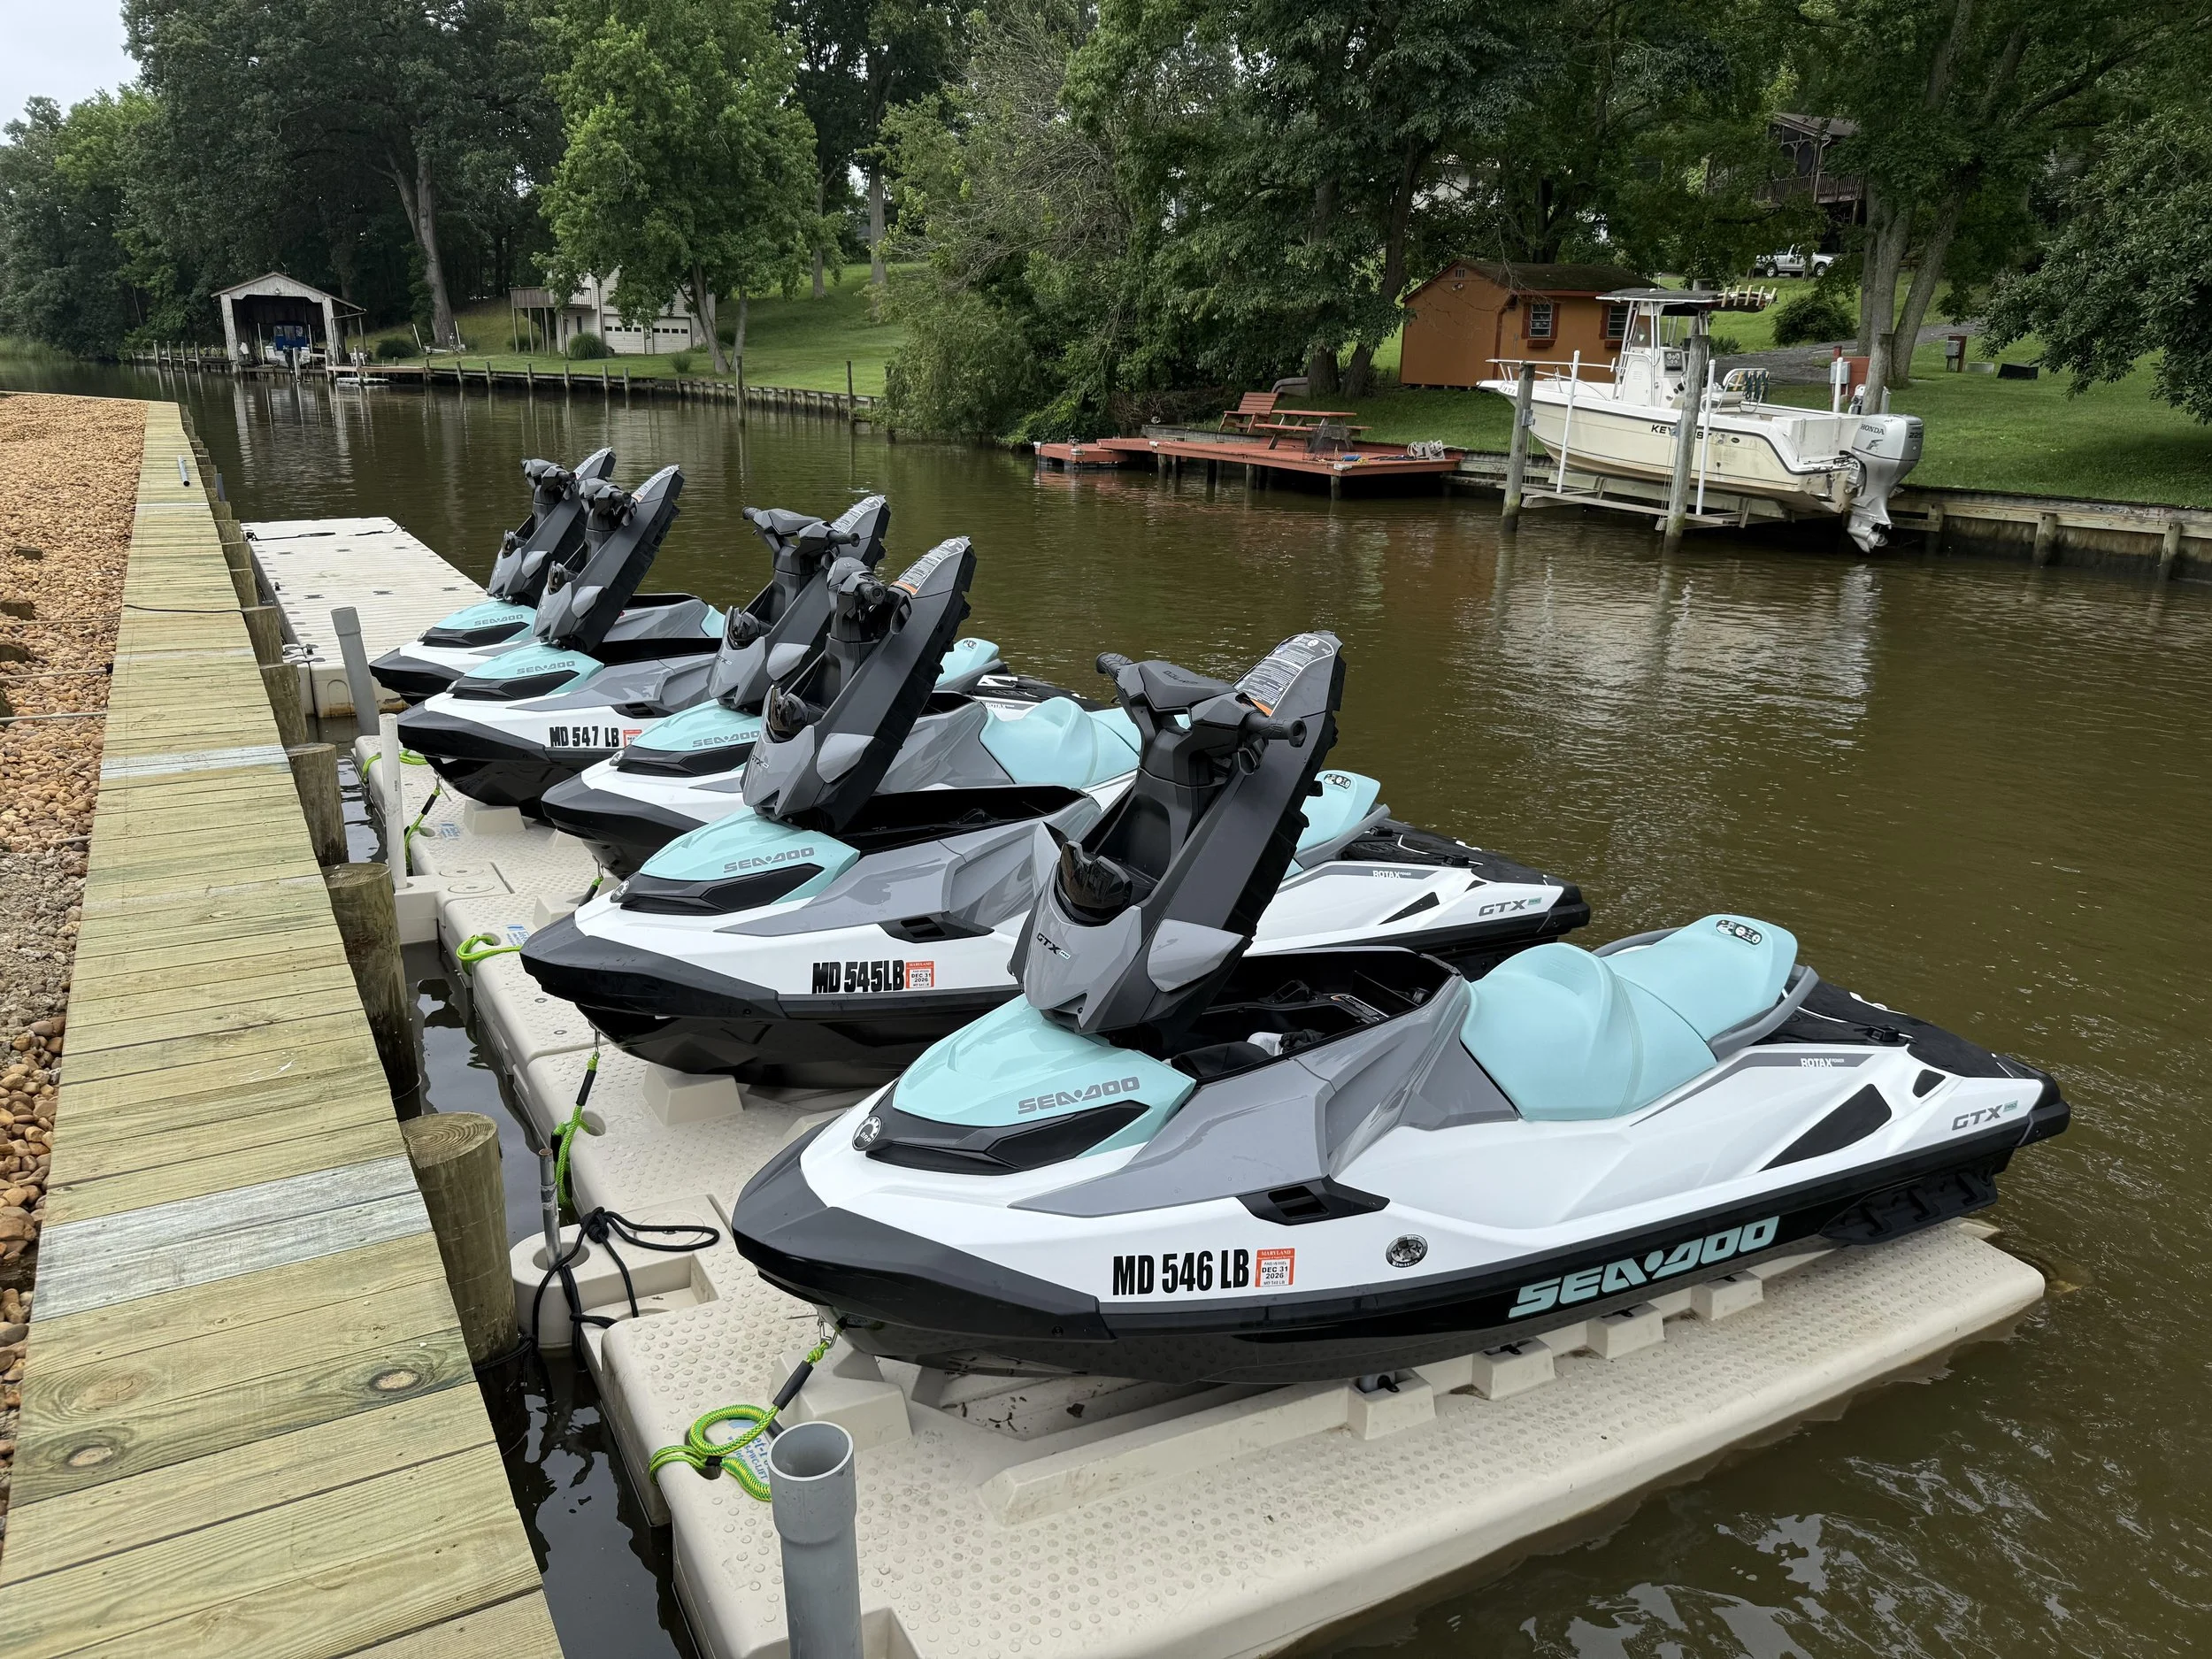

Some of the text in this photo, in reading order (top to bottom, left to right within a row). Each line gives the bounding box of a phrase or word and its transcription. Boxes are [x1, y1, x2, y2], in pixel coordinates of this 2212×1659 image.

[1860, 424, 1885, 434] HONDA
[549, 726, 619, 747] MD 547 LB
[1479, 899, 1527, 917] GTX
[1036, 933, 1061, 955] GTX
[812, 962, 841, 994] MD
[1800, 1057, 1832, 1067] ROTAX
[1952, 1104, 2003, 1131] GTX
[1112, 1248, 1249, 1296] MD 546 LB
